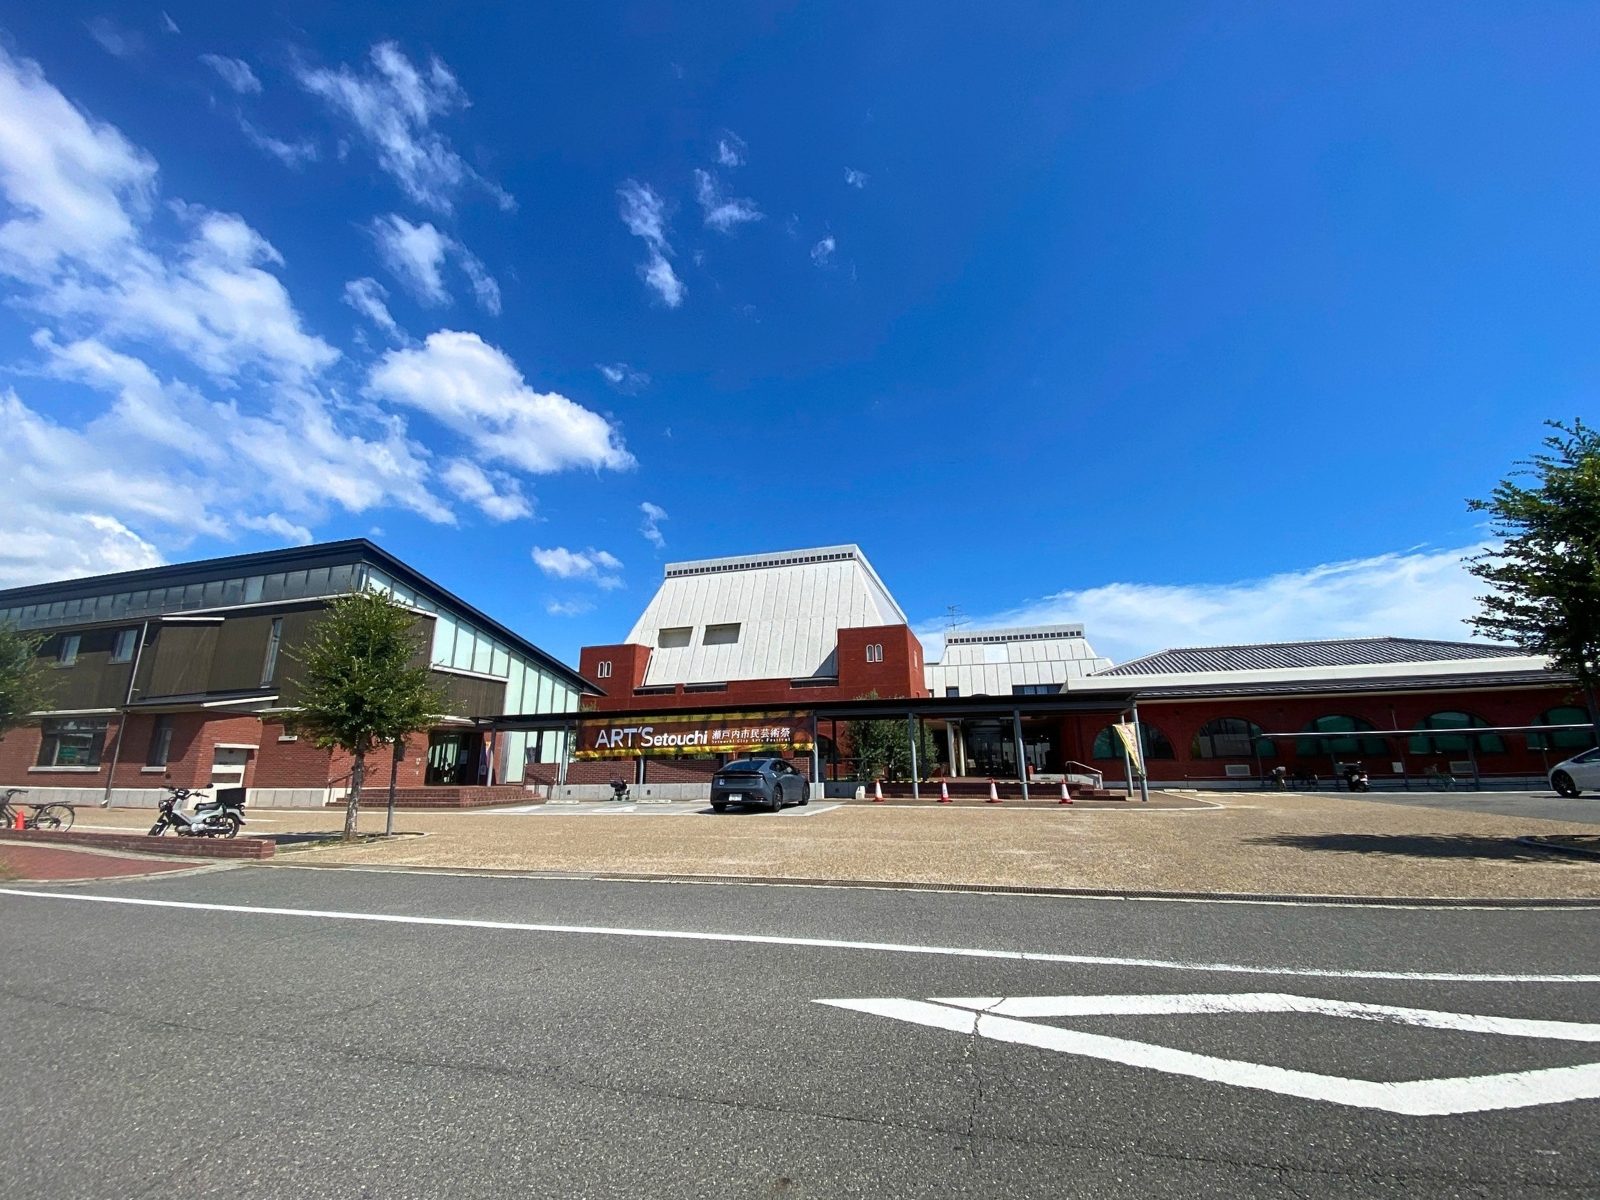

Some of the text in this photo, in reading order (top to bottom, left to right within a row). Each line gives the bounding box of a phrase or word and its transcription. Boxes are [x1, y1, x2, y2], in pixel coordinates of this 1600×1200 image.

[712, 728, 790, 739] 瀬戸内市民芸術祭
